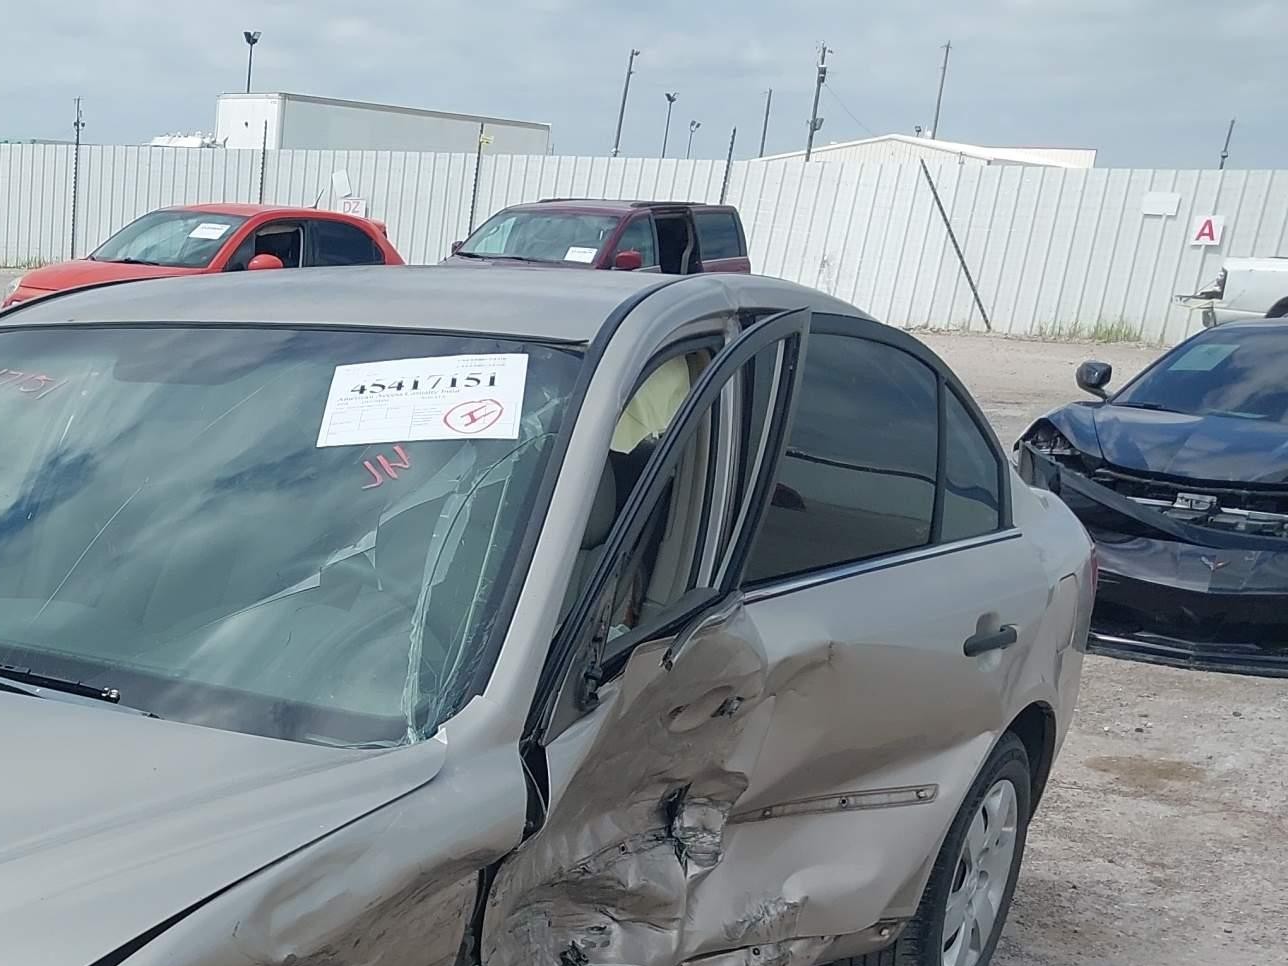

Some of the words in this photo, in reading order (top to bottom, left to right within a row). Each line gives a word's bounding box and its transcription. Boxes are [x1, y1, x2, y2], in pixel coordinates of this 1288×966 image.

[343, 201, 361, 213] DZ
[1195, 219, 1215, 241] A
[350, 371, 497, 395] 45417151
